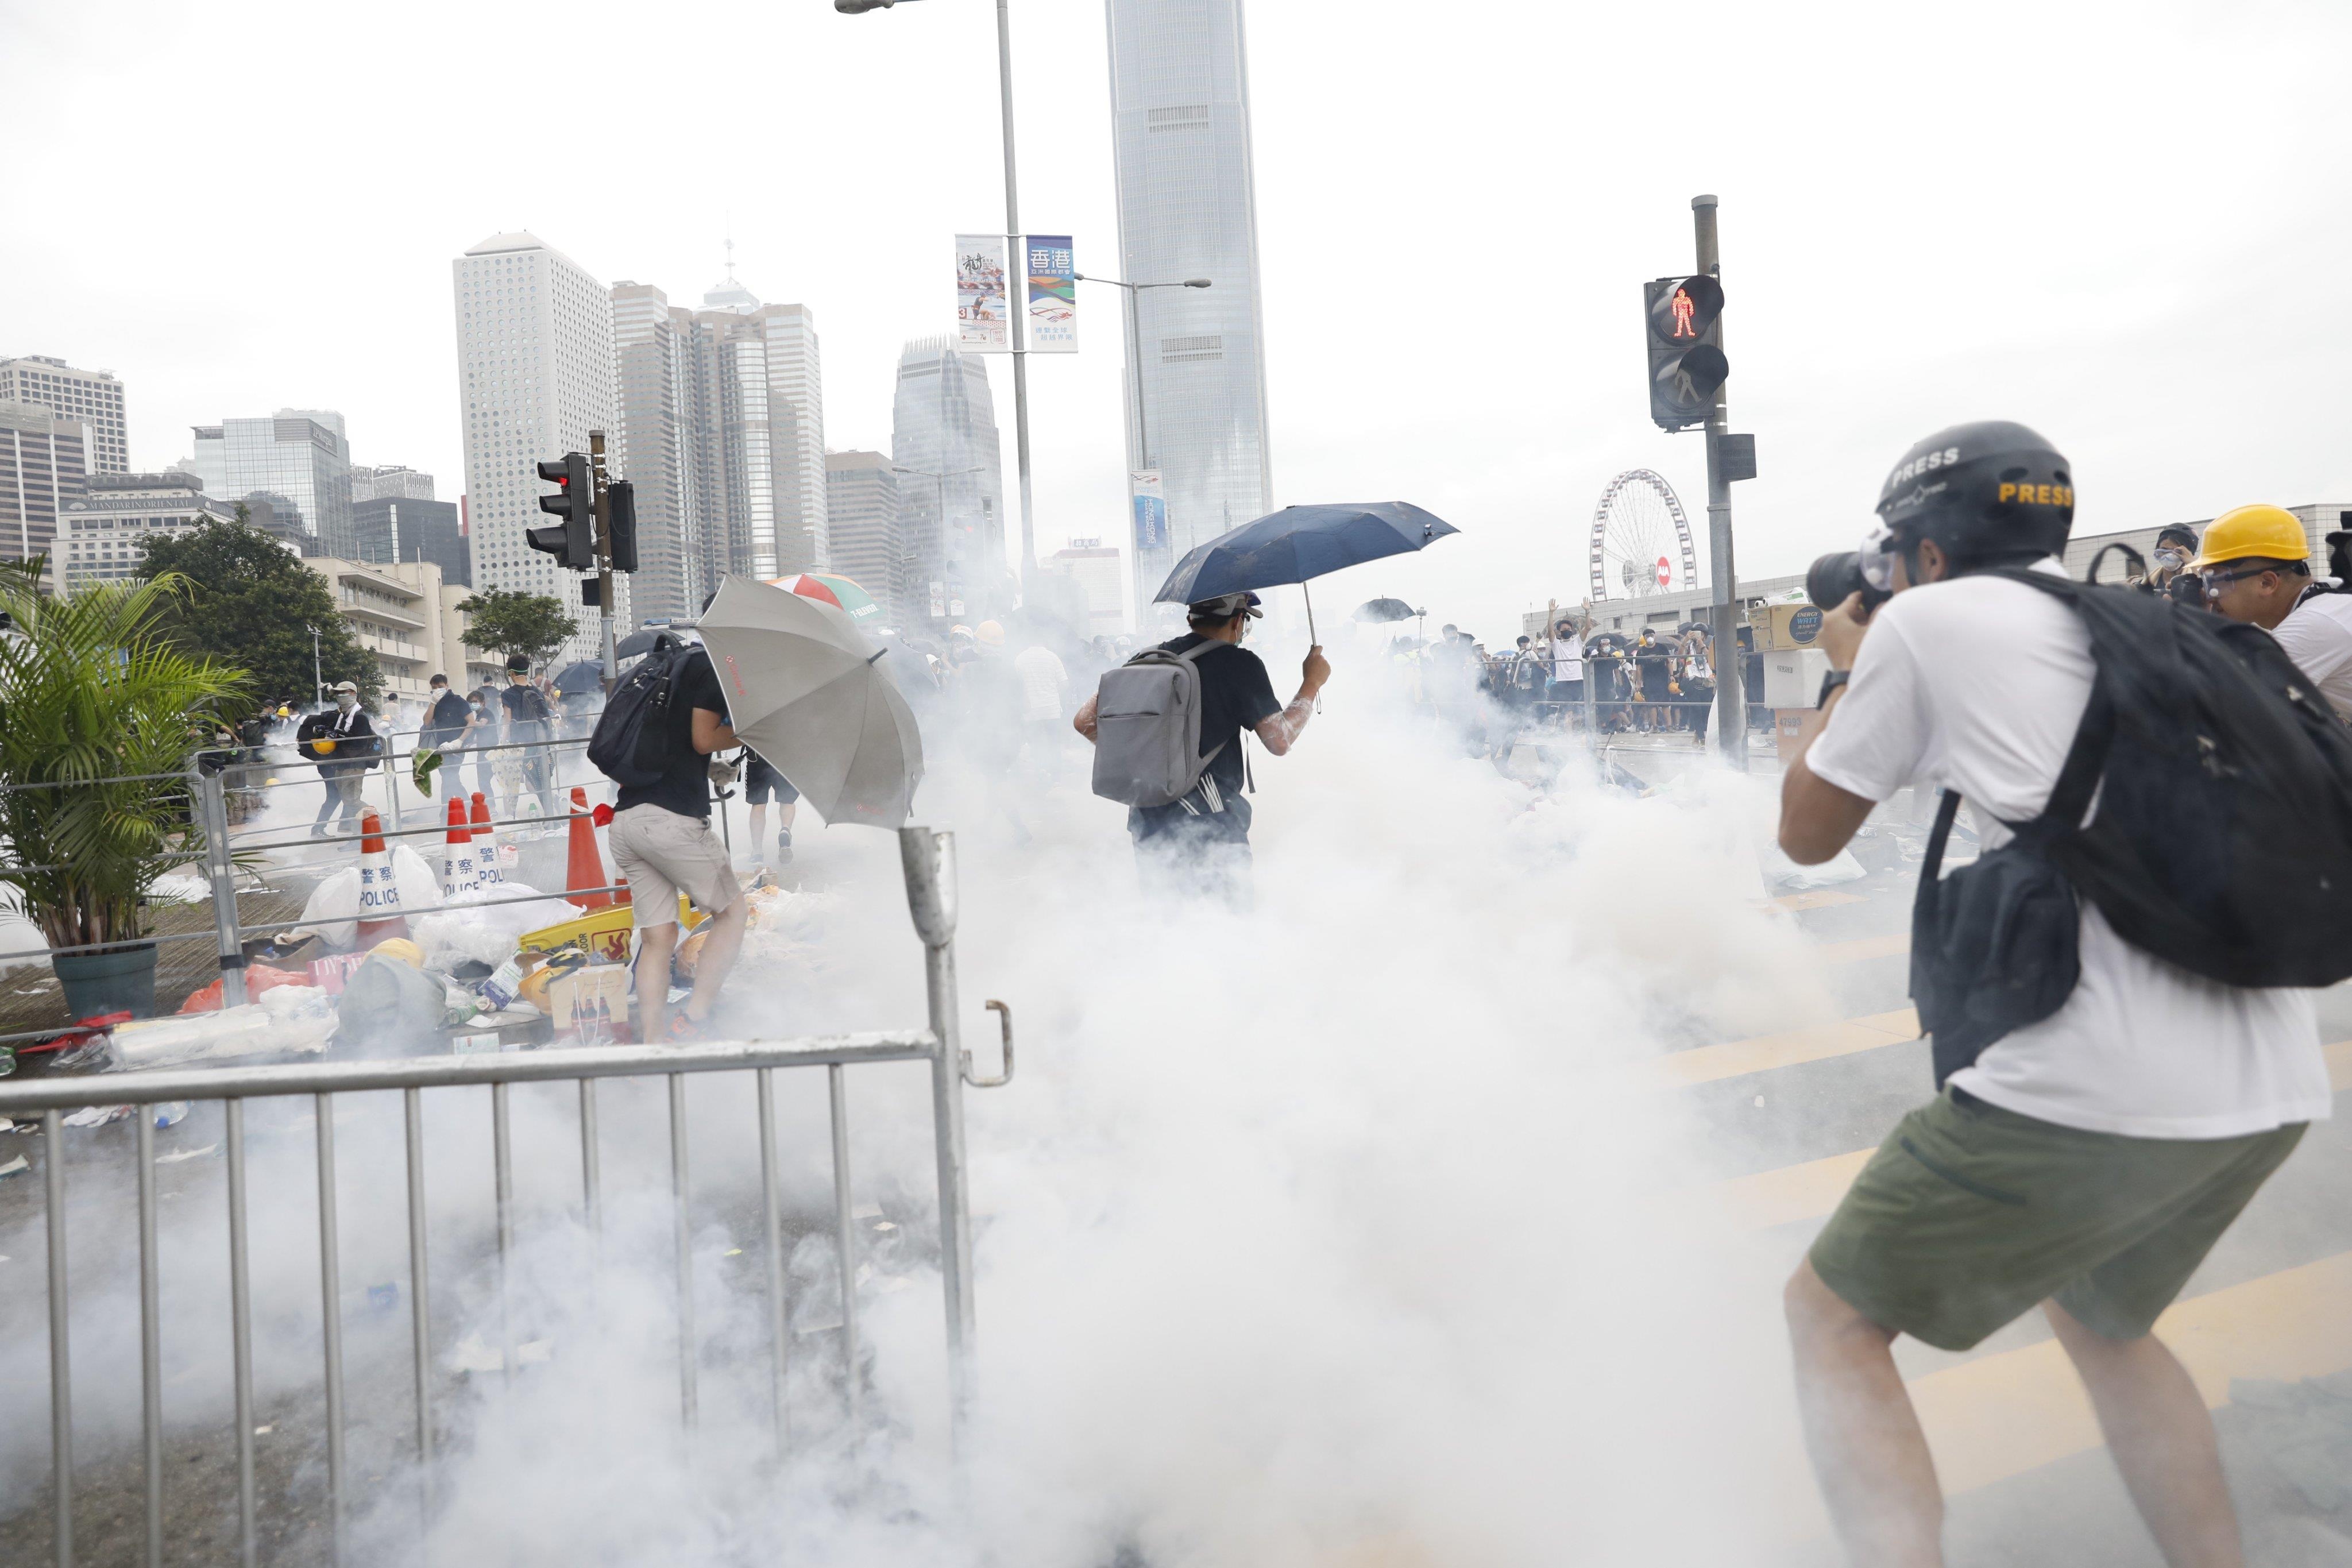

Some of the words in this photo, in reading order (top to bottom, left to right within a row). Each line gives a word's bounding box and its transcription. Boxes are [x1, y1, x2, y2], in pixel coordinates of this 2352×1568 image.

[1030, 249, 1070, 268] 香港
[1891, 446, 1960, 488] PRESS
[1998, 482, 2072, 507] PRESS
[90, 501, 143, 510] MANDARIN
[144, 500, 190, 509] ORIENTAL
[1658, 565, 1670, 577] AIA
[479, 847, 500, 863] 警
[362, 866, 392, 883] 警察
[359, 887, 399, 906] POLICE
[443, 881, 479, 897] OLICE
